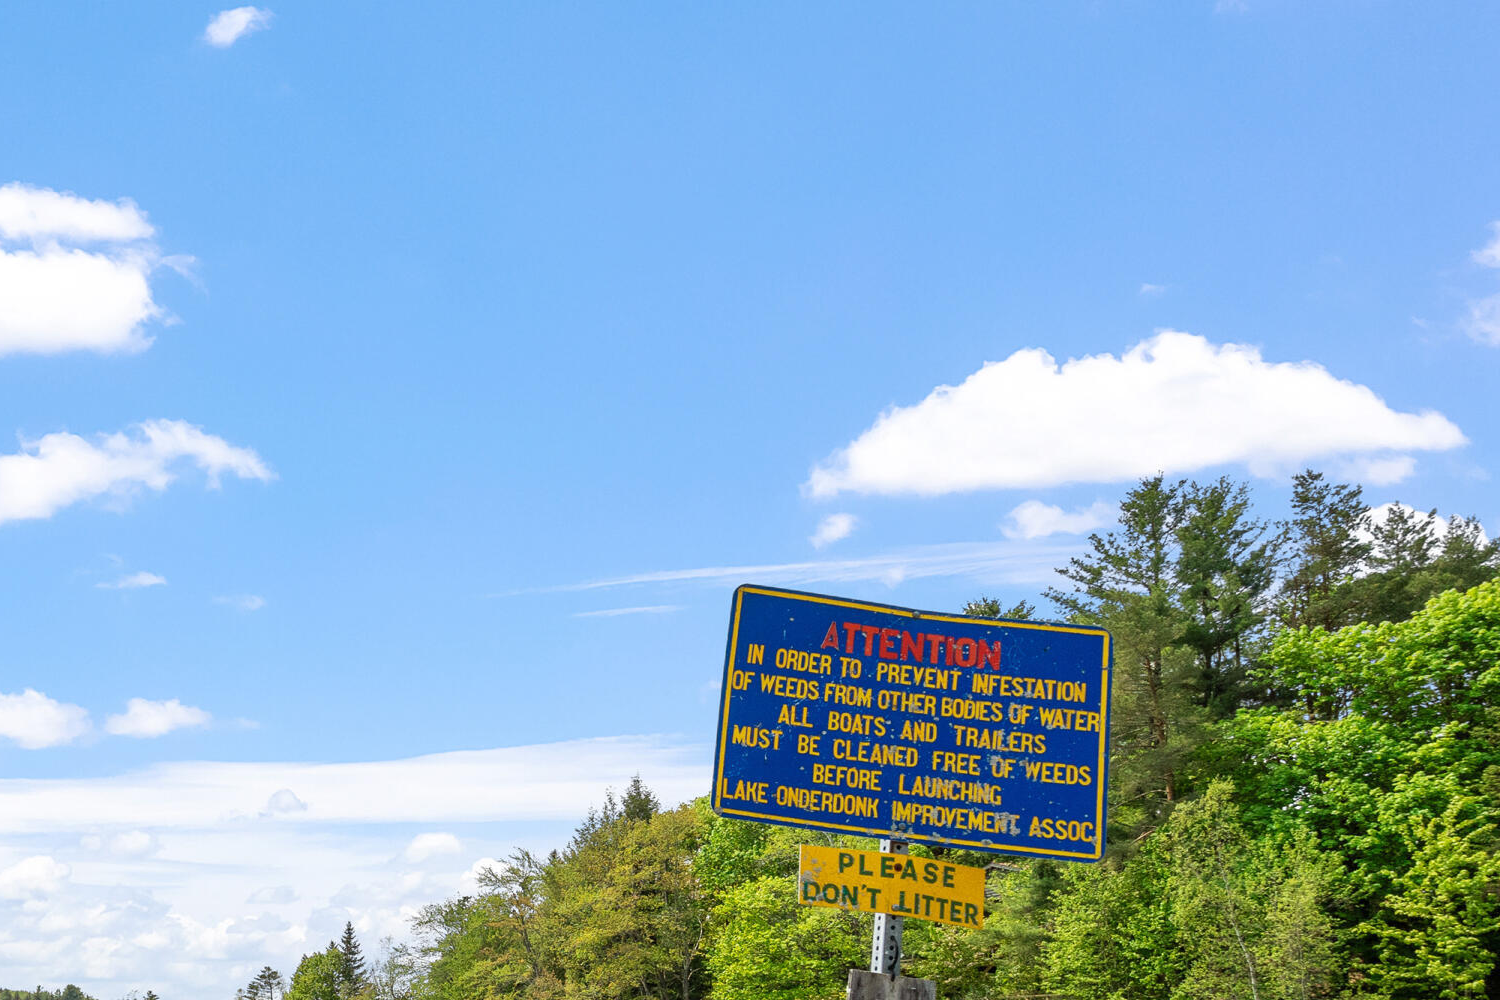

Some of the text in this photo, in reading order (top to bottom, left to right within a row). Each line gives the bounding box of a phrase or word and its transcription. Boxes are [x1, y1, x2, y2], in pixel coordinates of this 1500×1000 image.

[821, 621, 1001, 670] ATTENTION
[747, 644, 1086, 702] IN ORDER TO PREVENT INFESTATION
[732, 670, 1100, 732] OF WEEDS FROM OTHER BODIES OF WATER
[778, 704, 1046, 754] ALL BOATS AND TRAILERS
[732, 725, 1091, 786] MUST BE CLEANED FREE OF WEEDS
[813, 764, 1002, 805] BEFORE LAUNCHING
[722, 778, 1093, 842] LAKE ONDERDONK IMPROVEMENT ASSOC
[839, 853, 956, 888] PLEASE
[803, 881, 978, 926] DON'T LITTER
